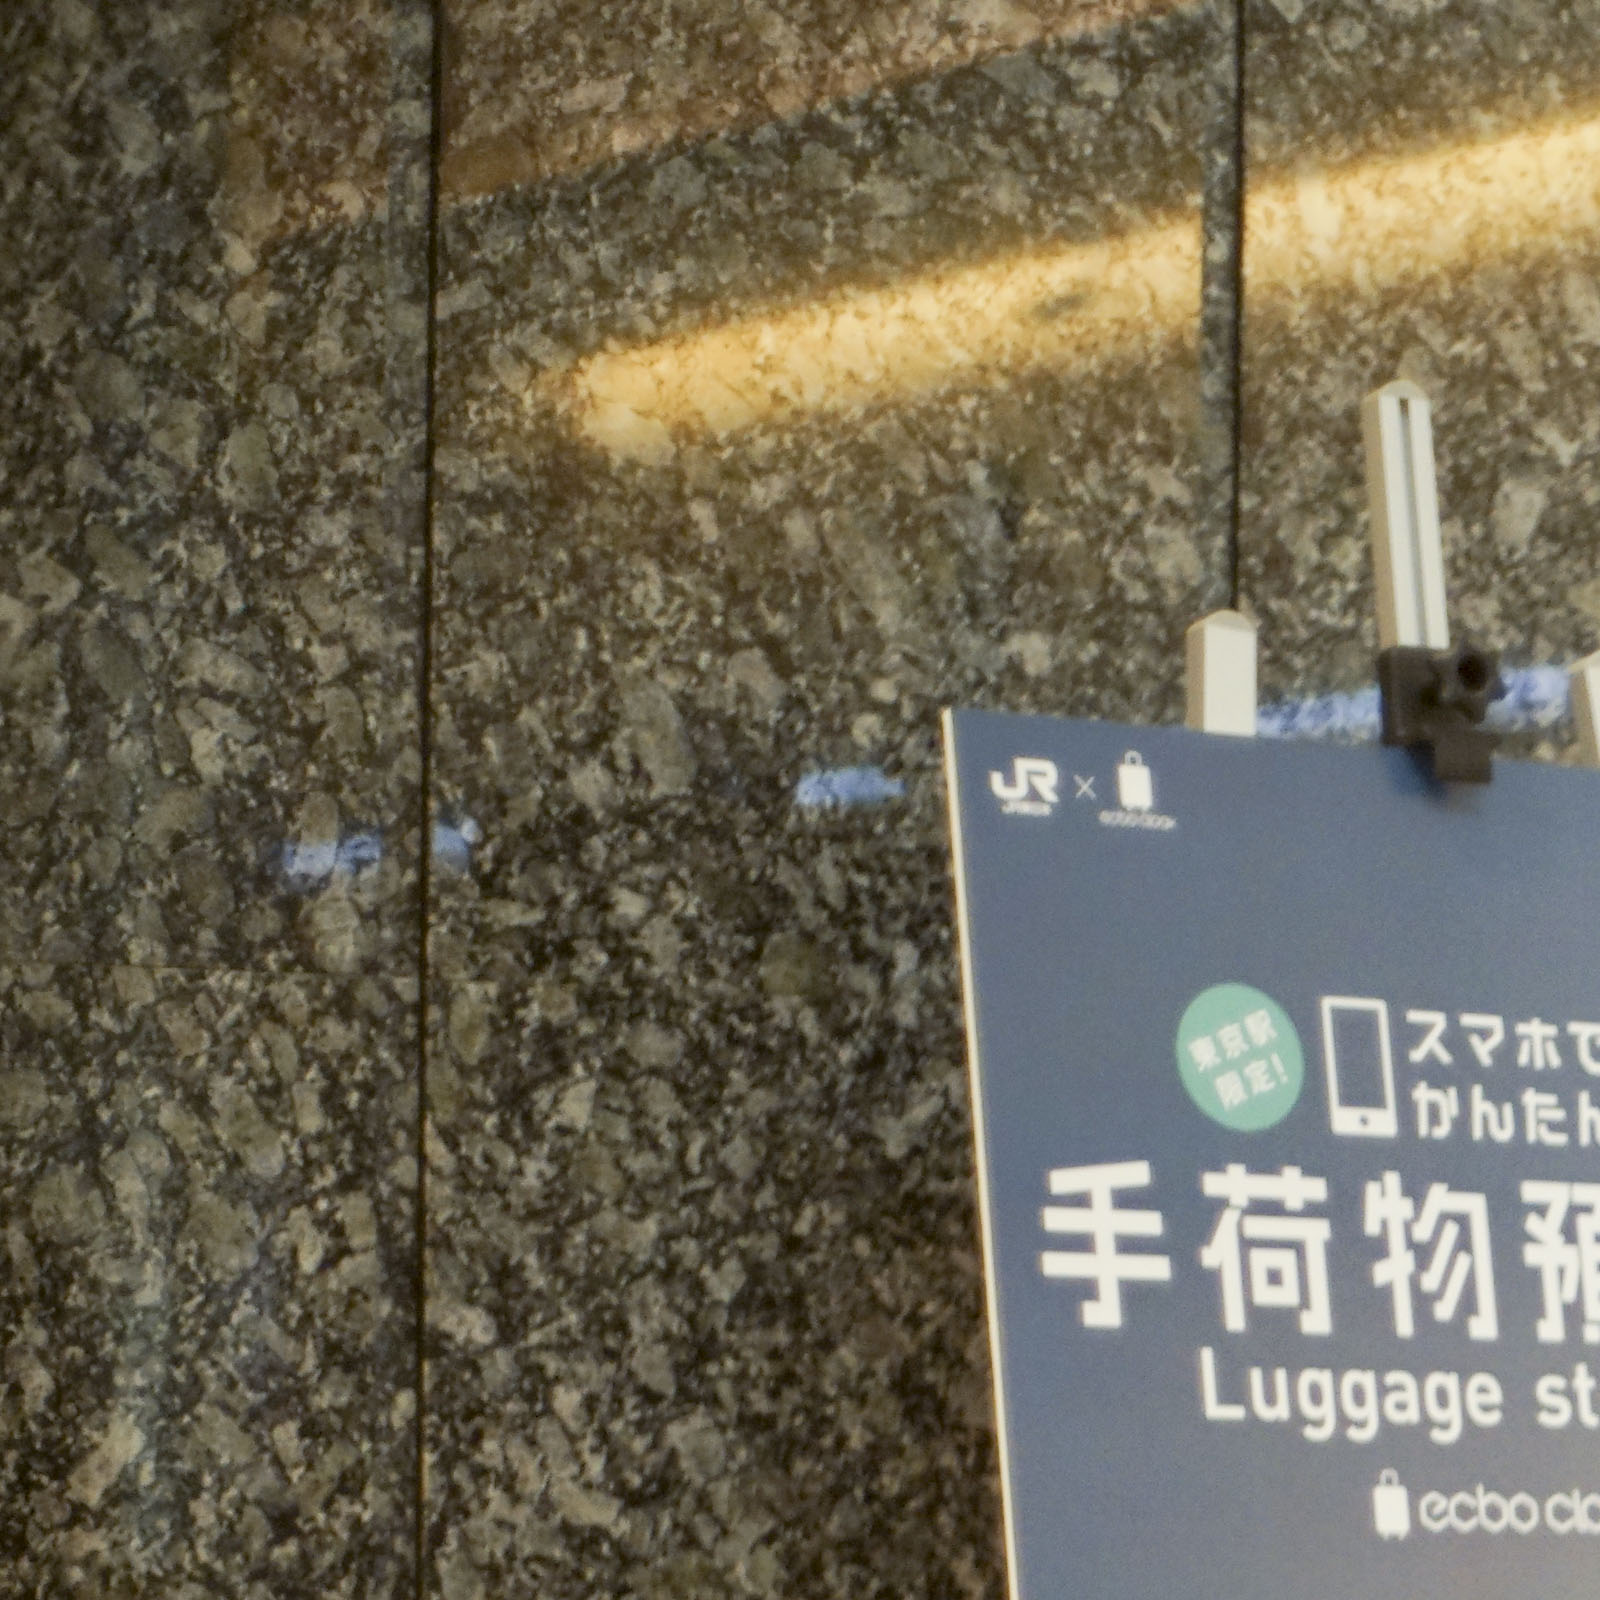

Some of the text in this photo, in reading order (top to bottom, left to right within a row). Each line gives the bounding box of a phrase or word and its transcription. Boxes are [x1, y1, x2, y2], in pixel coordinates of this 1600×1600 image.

[989, 757, 1059, 803] JR
[1200, 1344, 1503, 1444] Luggage
[1419, 1482, 1540, 1534] ecbo
